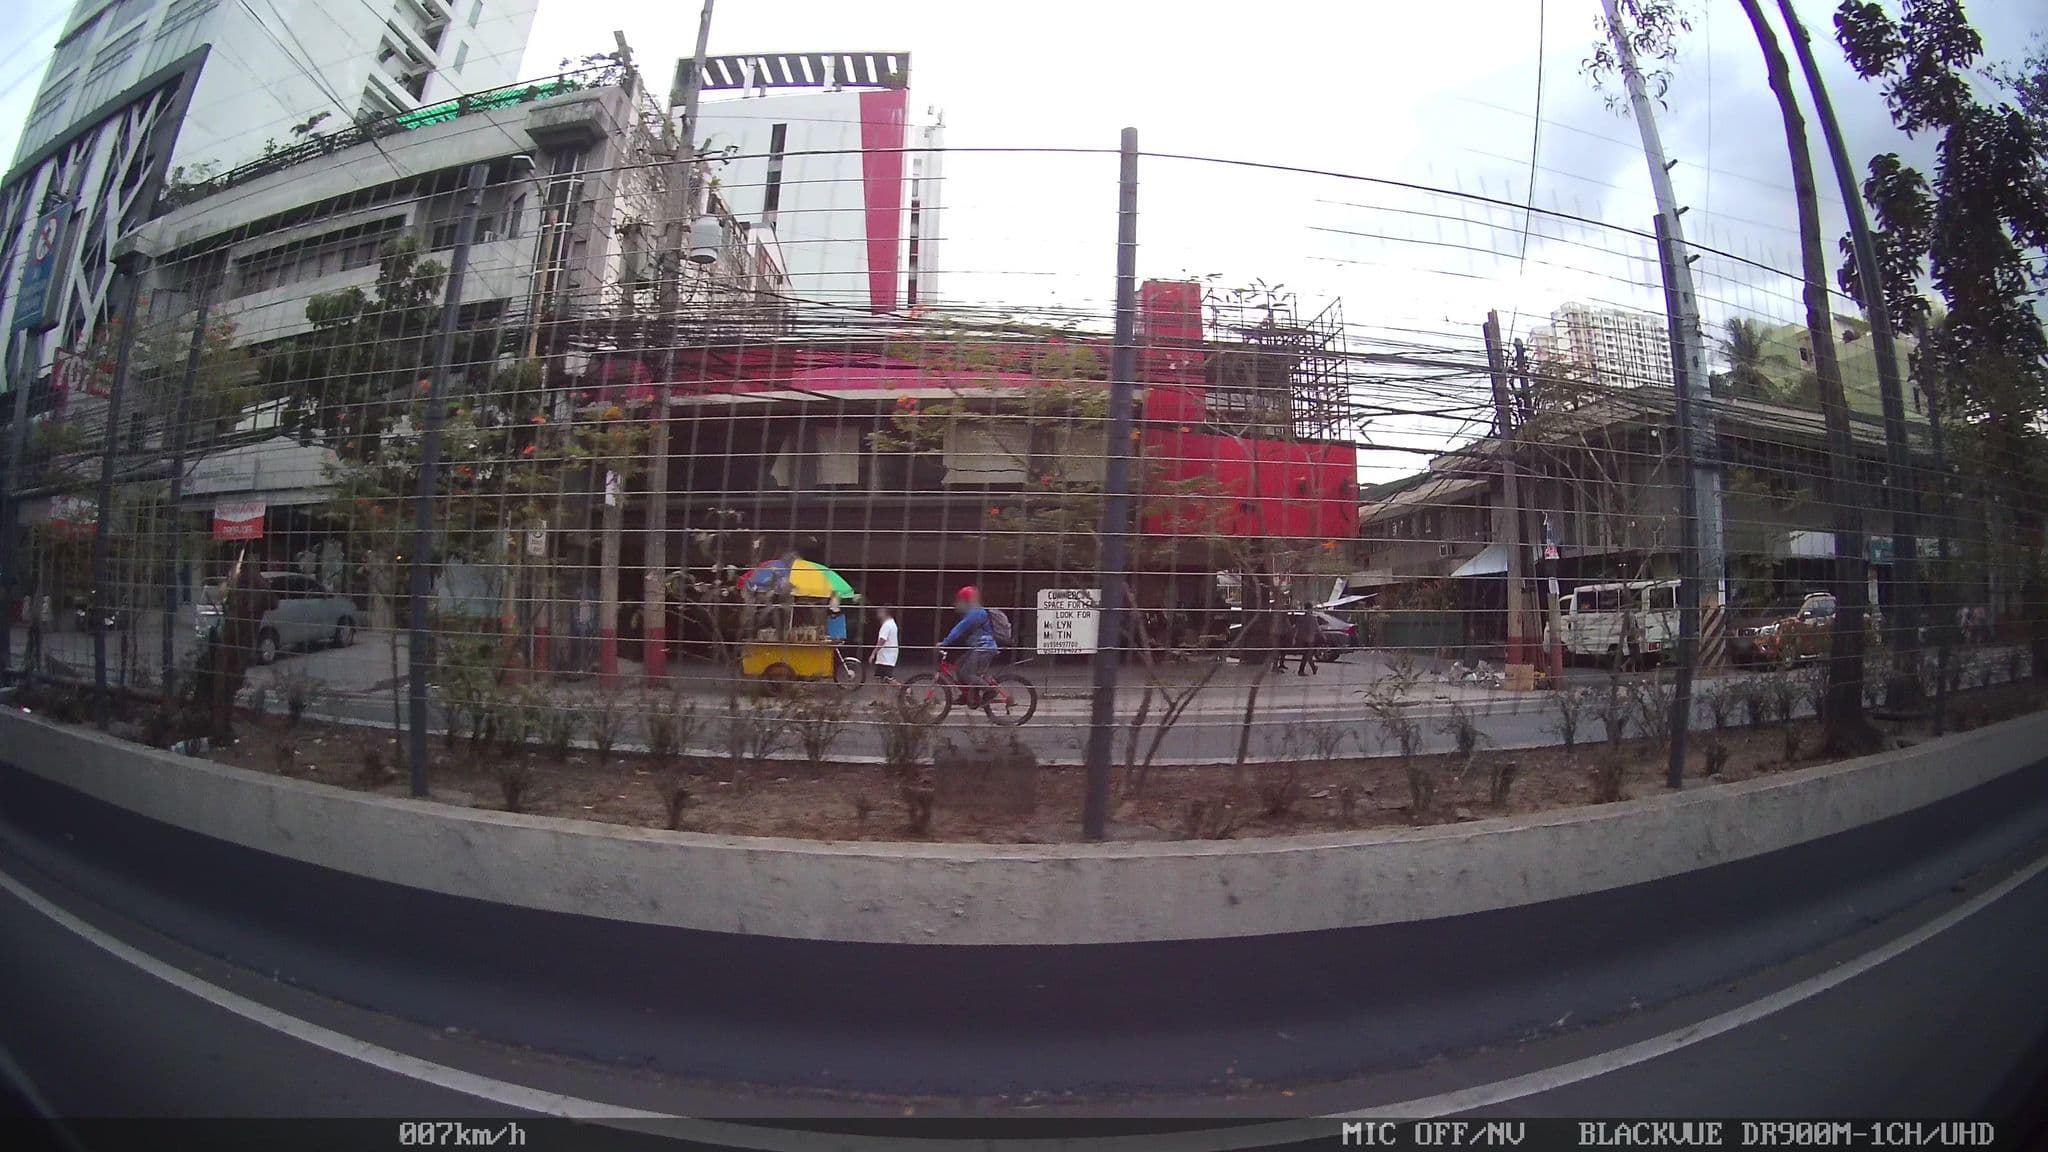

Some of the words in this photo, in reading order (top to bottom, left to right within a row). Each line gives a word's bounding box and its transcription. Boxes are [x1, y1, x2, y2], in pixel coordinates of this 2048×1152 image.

[1043, 601, 1064, 609] SPACE
[1067, 601, 1081, 609] FOR
[1056, 611, 1074, 619] LOOK
[1077, 611, 1091, 619] FOR
[1056, 621, 1072, 629] LYN
[1057, 631, 1072, 639] TIN
